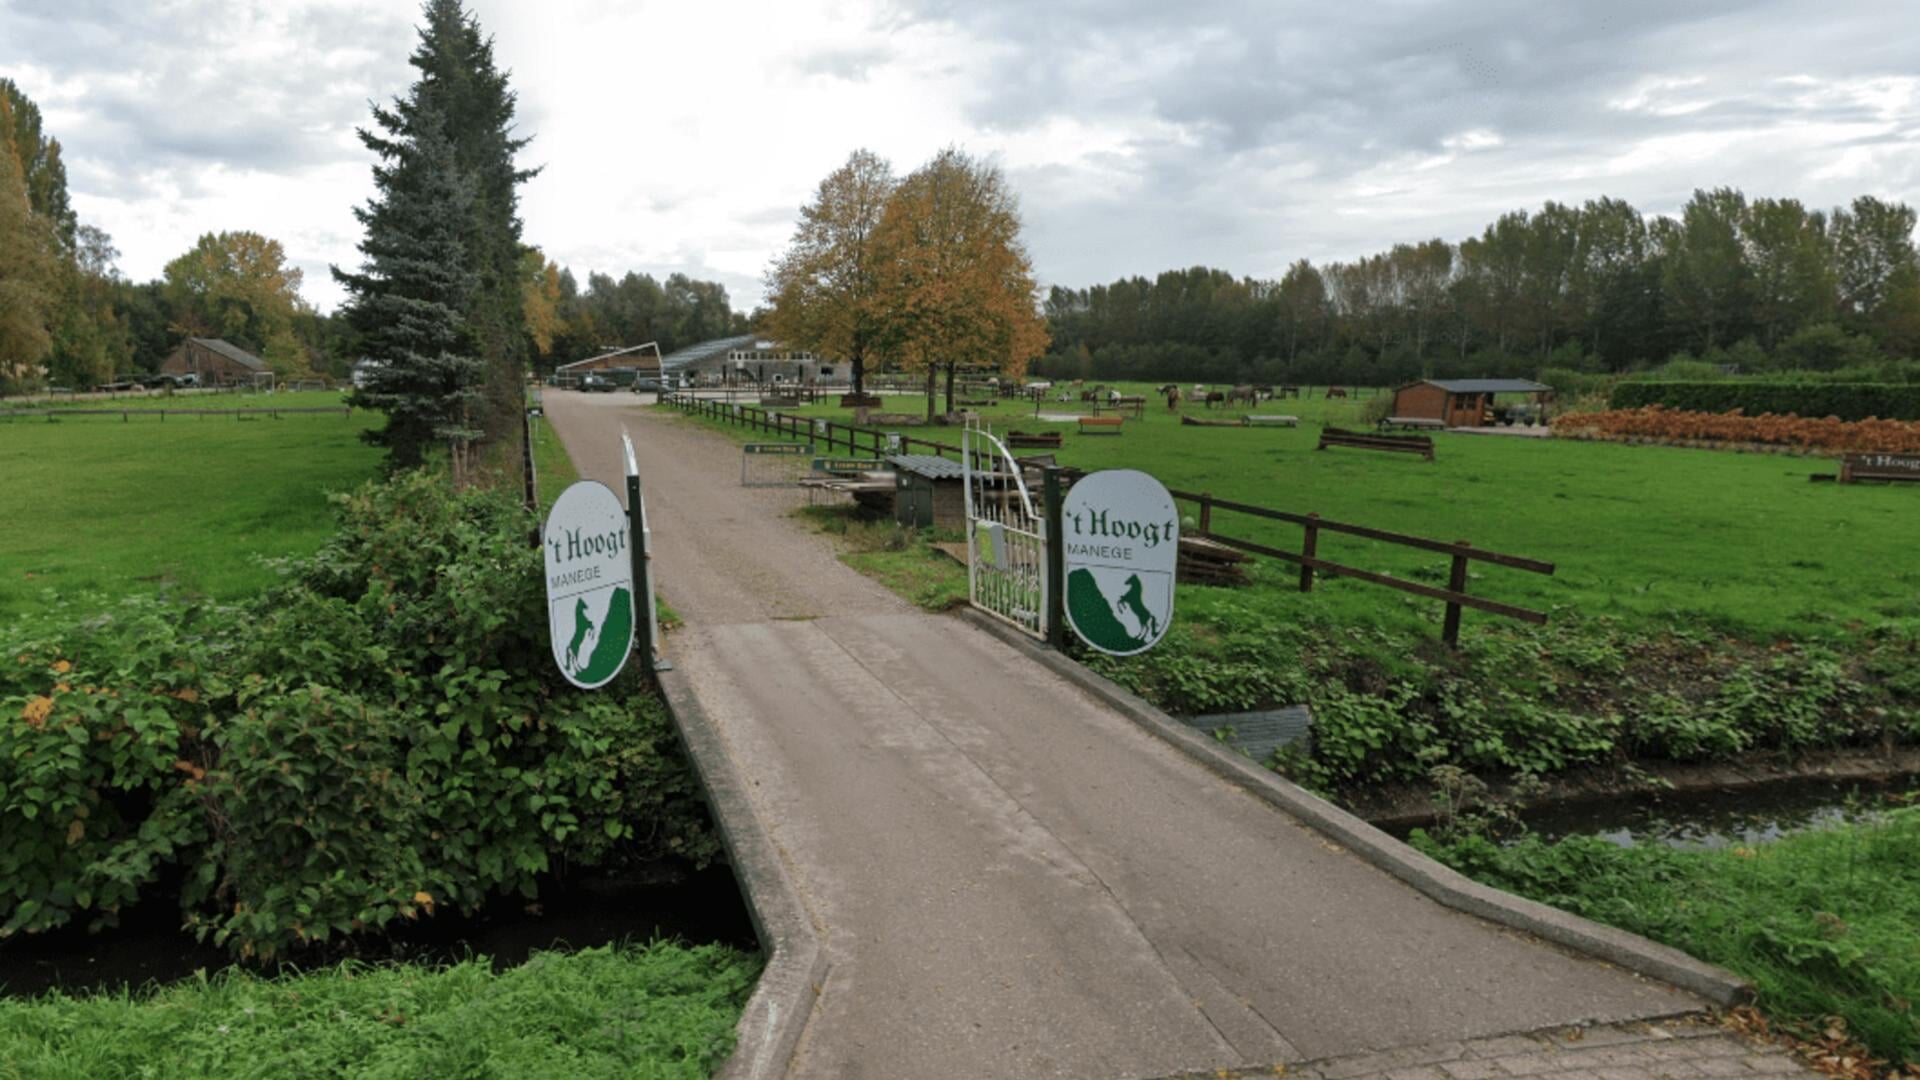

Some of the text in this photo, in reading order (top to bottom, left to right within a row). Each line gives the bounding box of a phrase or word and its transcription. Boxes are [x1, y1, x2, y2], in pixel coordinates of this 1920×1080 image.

[1088, 507, 1175, 548] Hoogt
[565, 526, 627, 560] Hoogt
[1067, 542, 1132, 560] MANEGE
[550, 565, 602, 589] MANEGE
